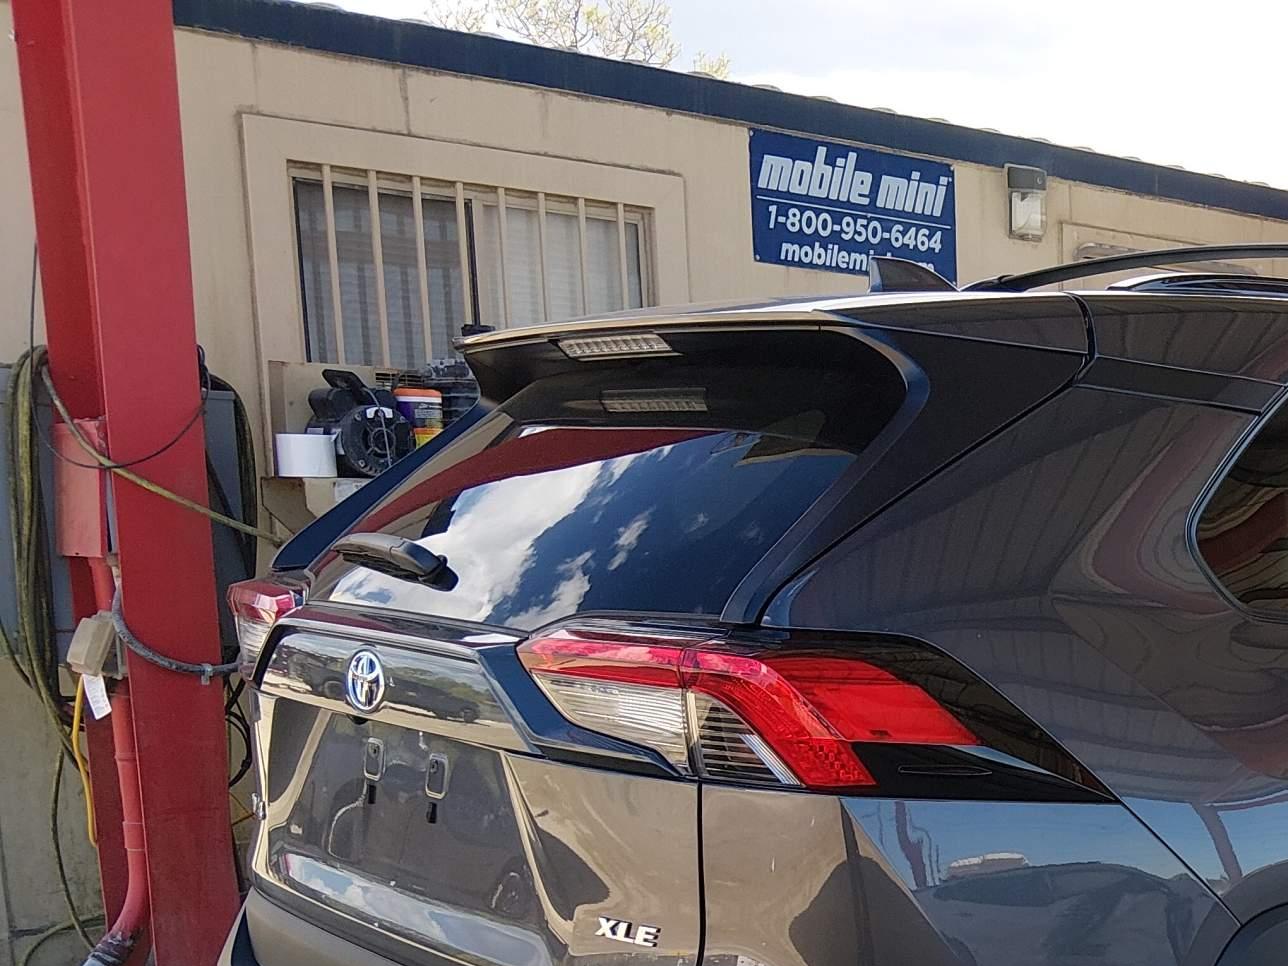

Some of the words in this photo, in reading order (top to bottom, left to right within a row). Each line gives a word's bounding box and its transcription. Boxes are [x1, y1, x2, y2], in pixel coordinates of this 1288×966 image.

[757, 145, 873, 205] mobile
[876, 169, 948, 217] mini
[767, 204, 943, 254] 1-800-950-6464
[594, 915, 661, 948] XLE
